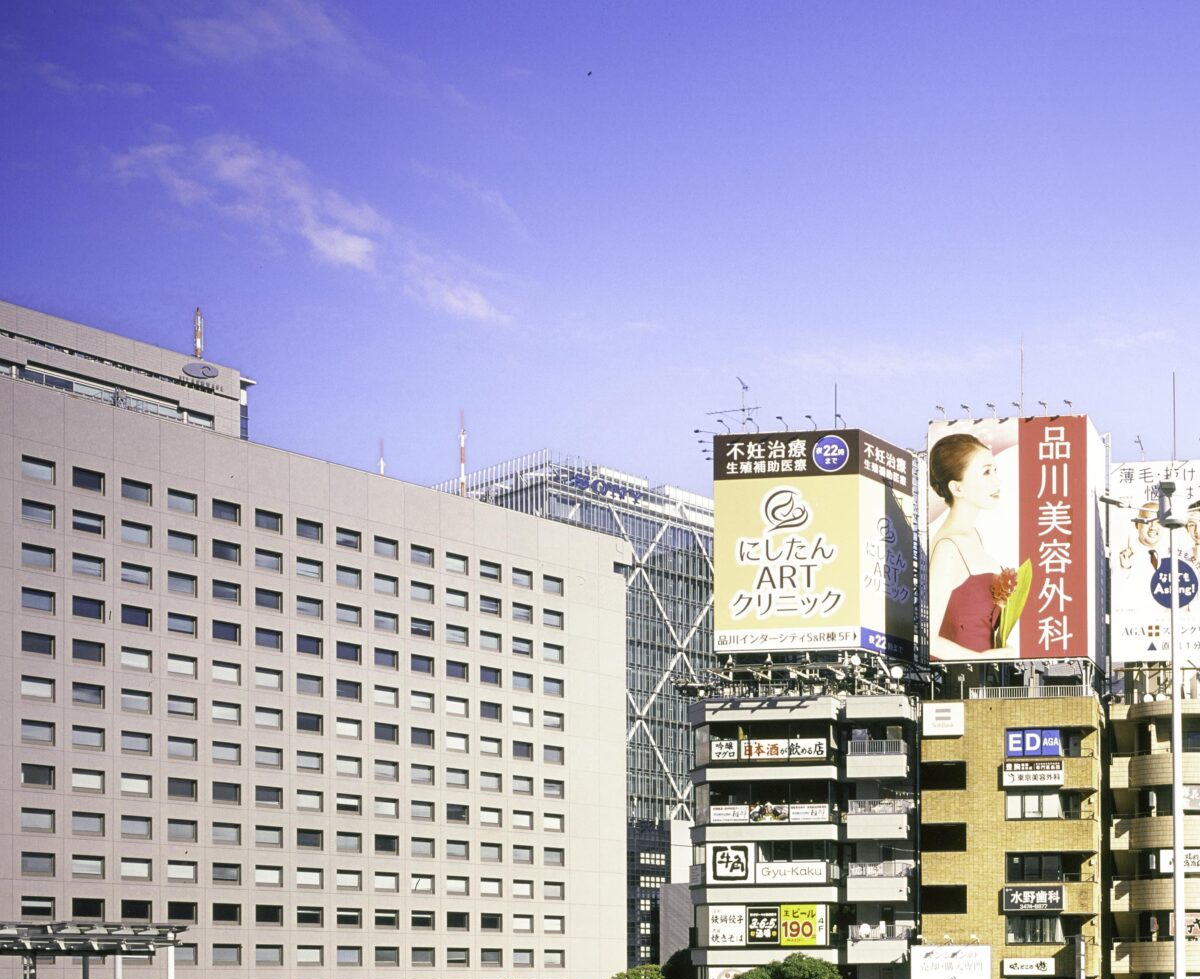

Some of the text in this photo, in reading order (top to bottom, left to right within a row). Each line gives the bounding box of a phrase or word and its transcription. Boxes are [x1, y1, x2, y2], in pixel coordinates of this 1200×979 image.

[726, 439, 807, 460] 不妊治療
[864, 442, 906, 474] 不妊治療
[726, 459, 807, 474] 生殖補助医療
[864, 459, 906, 487] 生殖補助医療
[575, 473, 643, 504] SONY
[739, 537, 834, 561] にしたん
[1037, 426, 1073, 651] 品川美容外科
[866, 543, 905, 569] にしたん
[756, 564, 818, 590] ART
[873, 562, 899, 583] ART
[864, 575, 909, 601] クリニック
[732, 591, 841, 616] クリニック
[717, 631, 850, 646] 品川インターシティS&R棟 5F
[743, 741, 824, 757] 日本酒が飲める店
[1008, 733, 1059, 751] ED AGA
[715, 751, 735, 759] マグロ
[1017, 773, 1061, 782] 東京美容外科
[718, 852, 745, 873] 牛角
[761, 866, 822, 878] Gyu-Kaku
[1010, 890, 1061, 903] 水野歯科
[782, 921, 813, 938] 190
